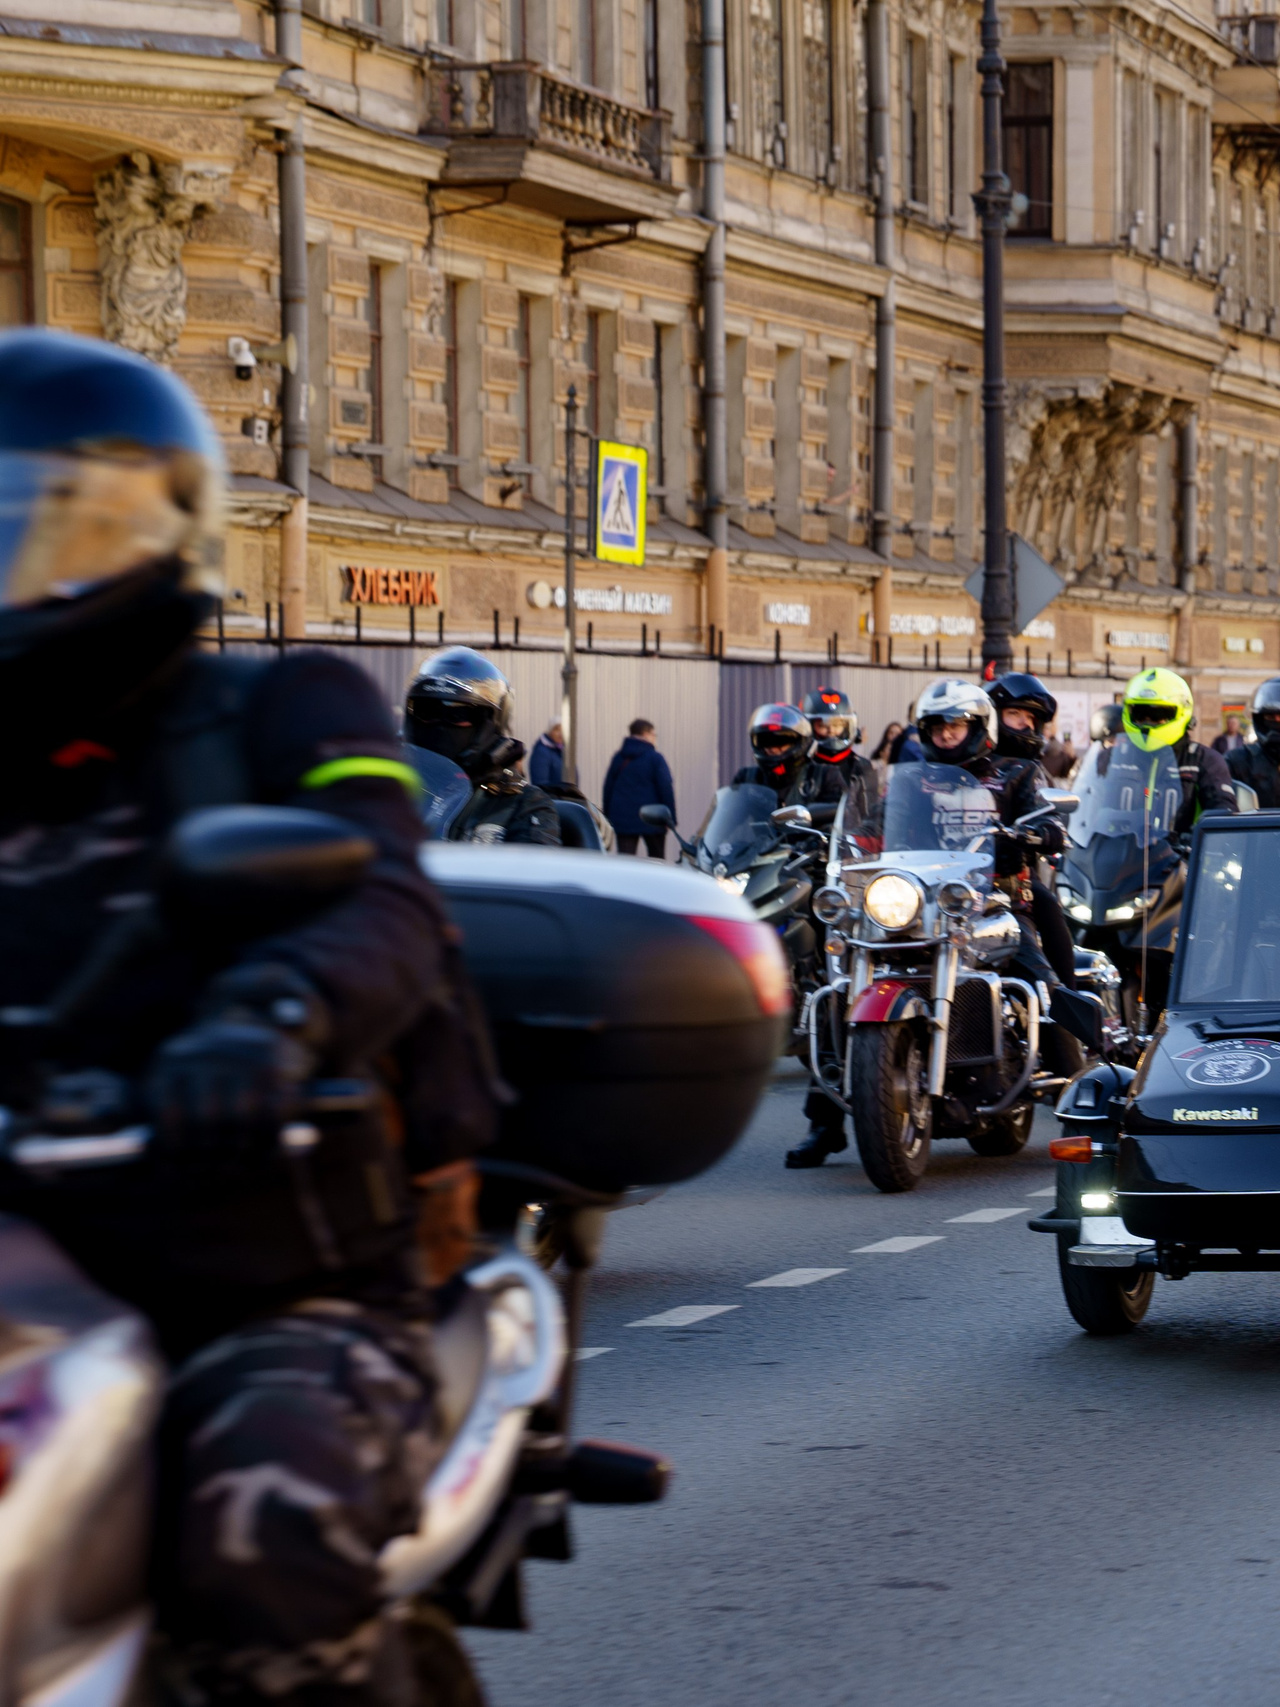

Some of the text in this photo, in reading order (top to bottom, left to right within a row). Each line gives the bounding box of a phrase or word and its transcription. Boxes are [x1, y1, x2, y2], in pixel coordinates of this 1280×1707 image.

[349, 565, 440, 606] ХЛЕБНИК
[624, 591, 673, 615] МАГАЗИН
[932, 809, 1001, 825] ICON
[1172, 1107, 1259, 1122] Kawasaki
